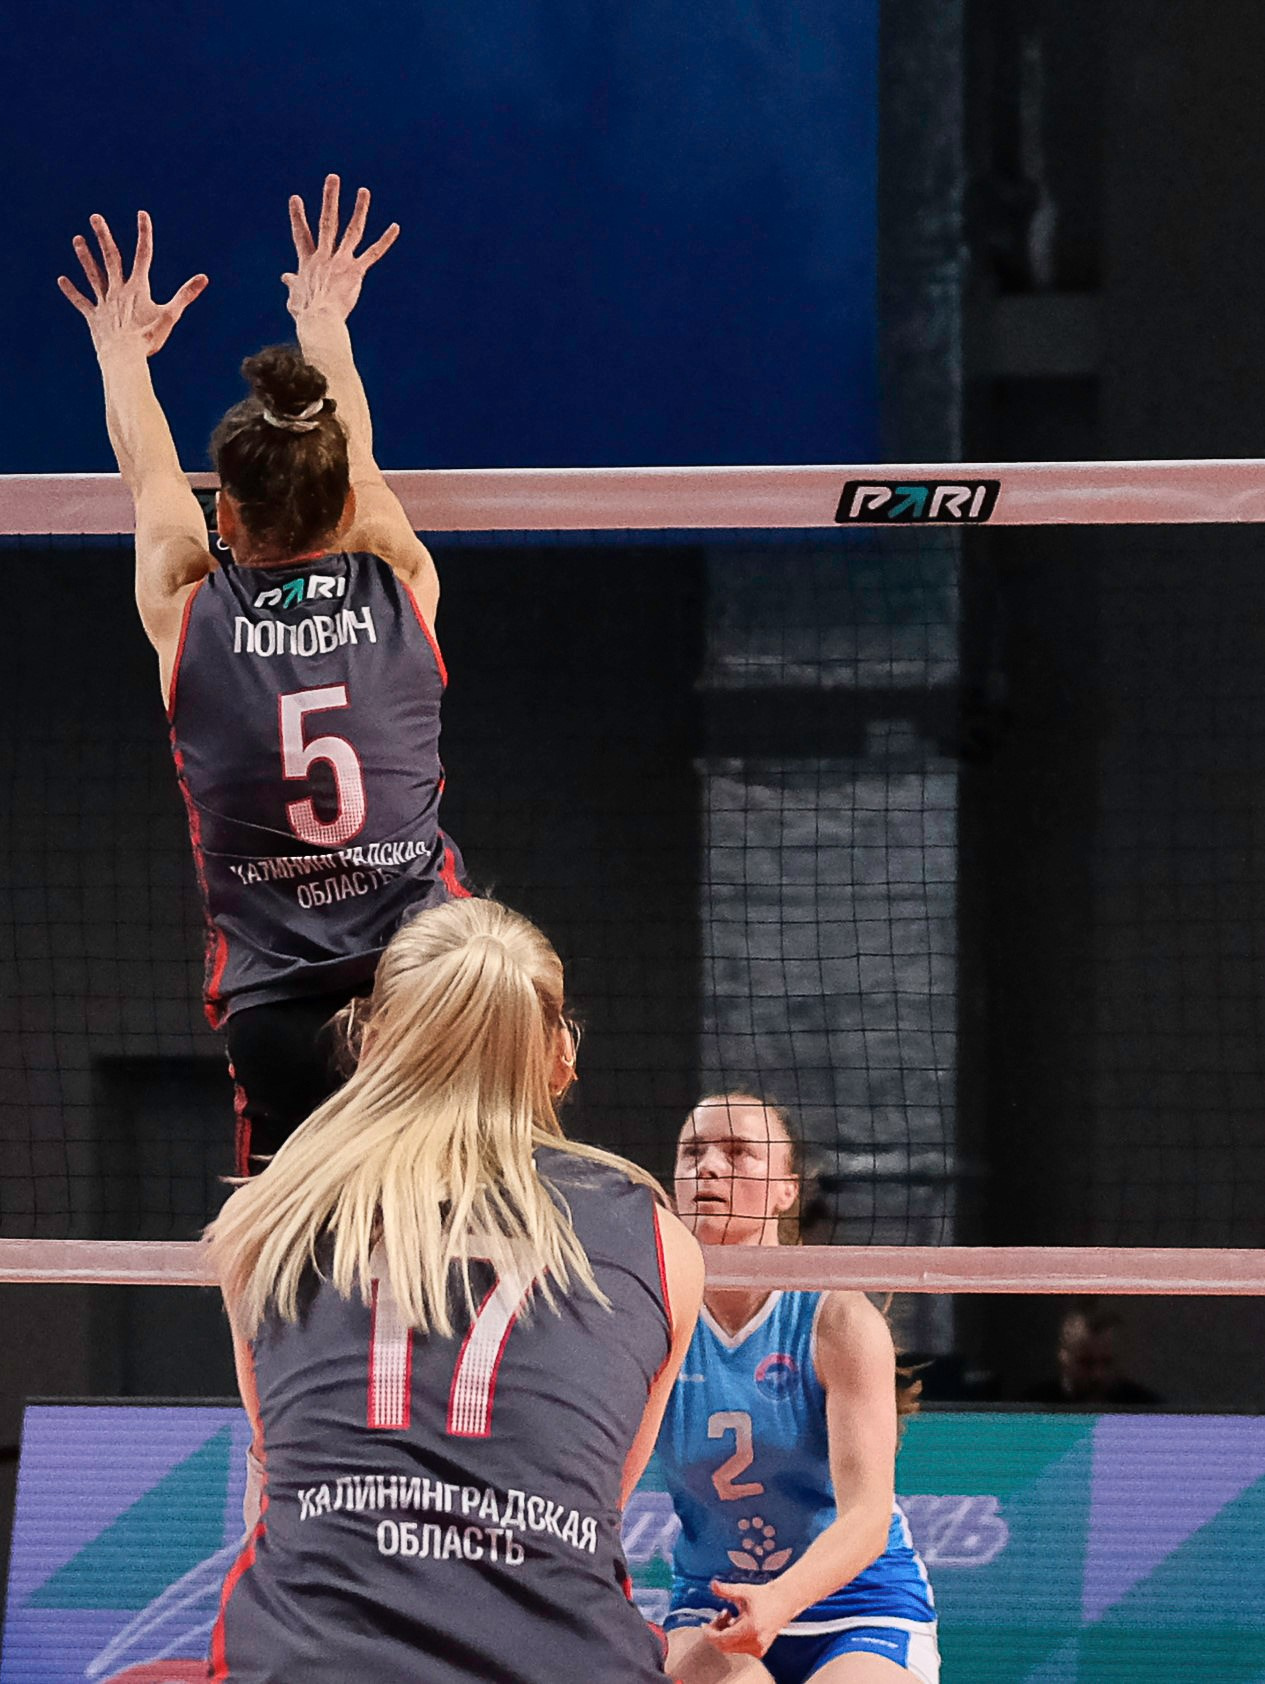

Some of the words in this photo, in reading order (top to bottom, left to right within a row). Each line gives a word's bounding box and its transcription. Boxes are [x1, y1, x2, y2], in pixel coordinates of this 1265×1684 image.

[849, 485, 986, 519] PARI
[253, 575, 346, 608] PARI
[233, 606, 377, 657] ПОПОВИЧ
[277, 682, 368, 847] 5
[297, 868, 395, 909] ОБЛАСТЬ
[367, 1234, 551, 1438] 17
[708, 1411, 764, 1499] 2
[297, 1474, 597, 1554] КАЛИНИНГРАДСКАЯ
[376, 1519, 525, 1566] ОБЛАСТЬ
